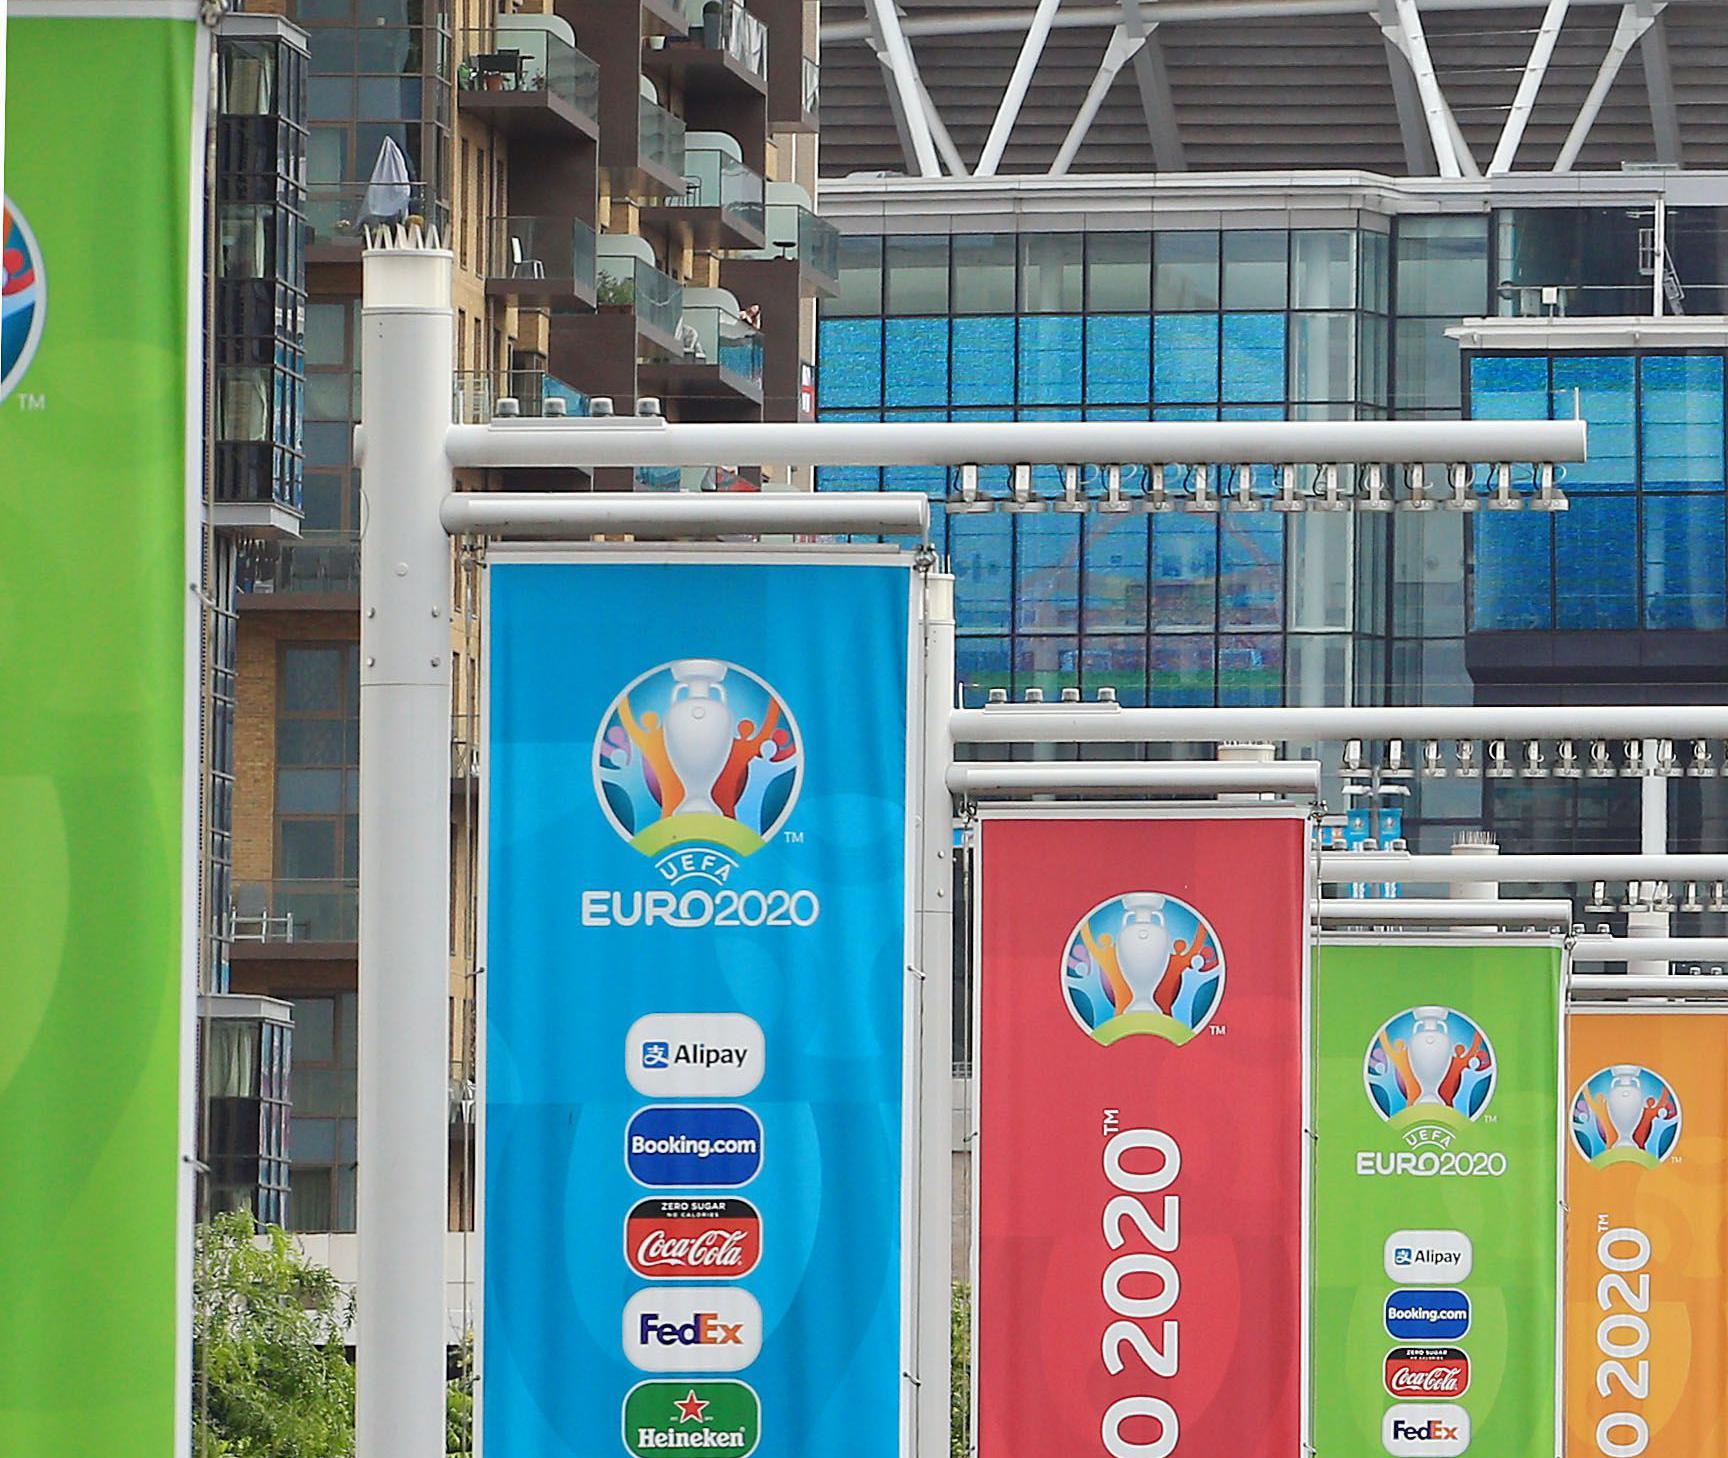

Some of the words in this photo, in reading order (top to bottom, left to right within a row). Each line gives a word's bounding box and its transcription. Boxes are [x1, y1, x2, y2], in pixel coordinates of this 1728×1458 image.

[660, 853, 731, 882] UEFA
[581, 889, 820, 928] EURO2020
[1209, 1024, 1226, 1036] TM
[674, 1042, 748, 1070] Alipay
[631, 1133, 757, 1158] Booking.com
[1404, 1128, 1452, 1147] UEFA
[1355, 1151, 1507, 1176] EURO2020
[661, 1202, 689, 1212] ZERO
[691, 1202, 727, 1211] SUGAR
[637, 1228, 743, 1270] Coca-Cola
[1102, 1128, 1182, 1378] 2020
[1415, 1249, 1461, 1266] Alipay
[1388, 1306, 1467, 1322] Booking.com
[1596, 1227, 1652, 1399] 2020
[640, 1312, 744, 1346] FedEx
[1391, 1364, 1458, 1391] Coca-Cola
[637, 1427, 742, 1449] Heineken
[1393, 1420, 1458, 1441] FedEx
